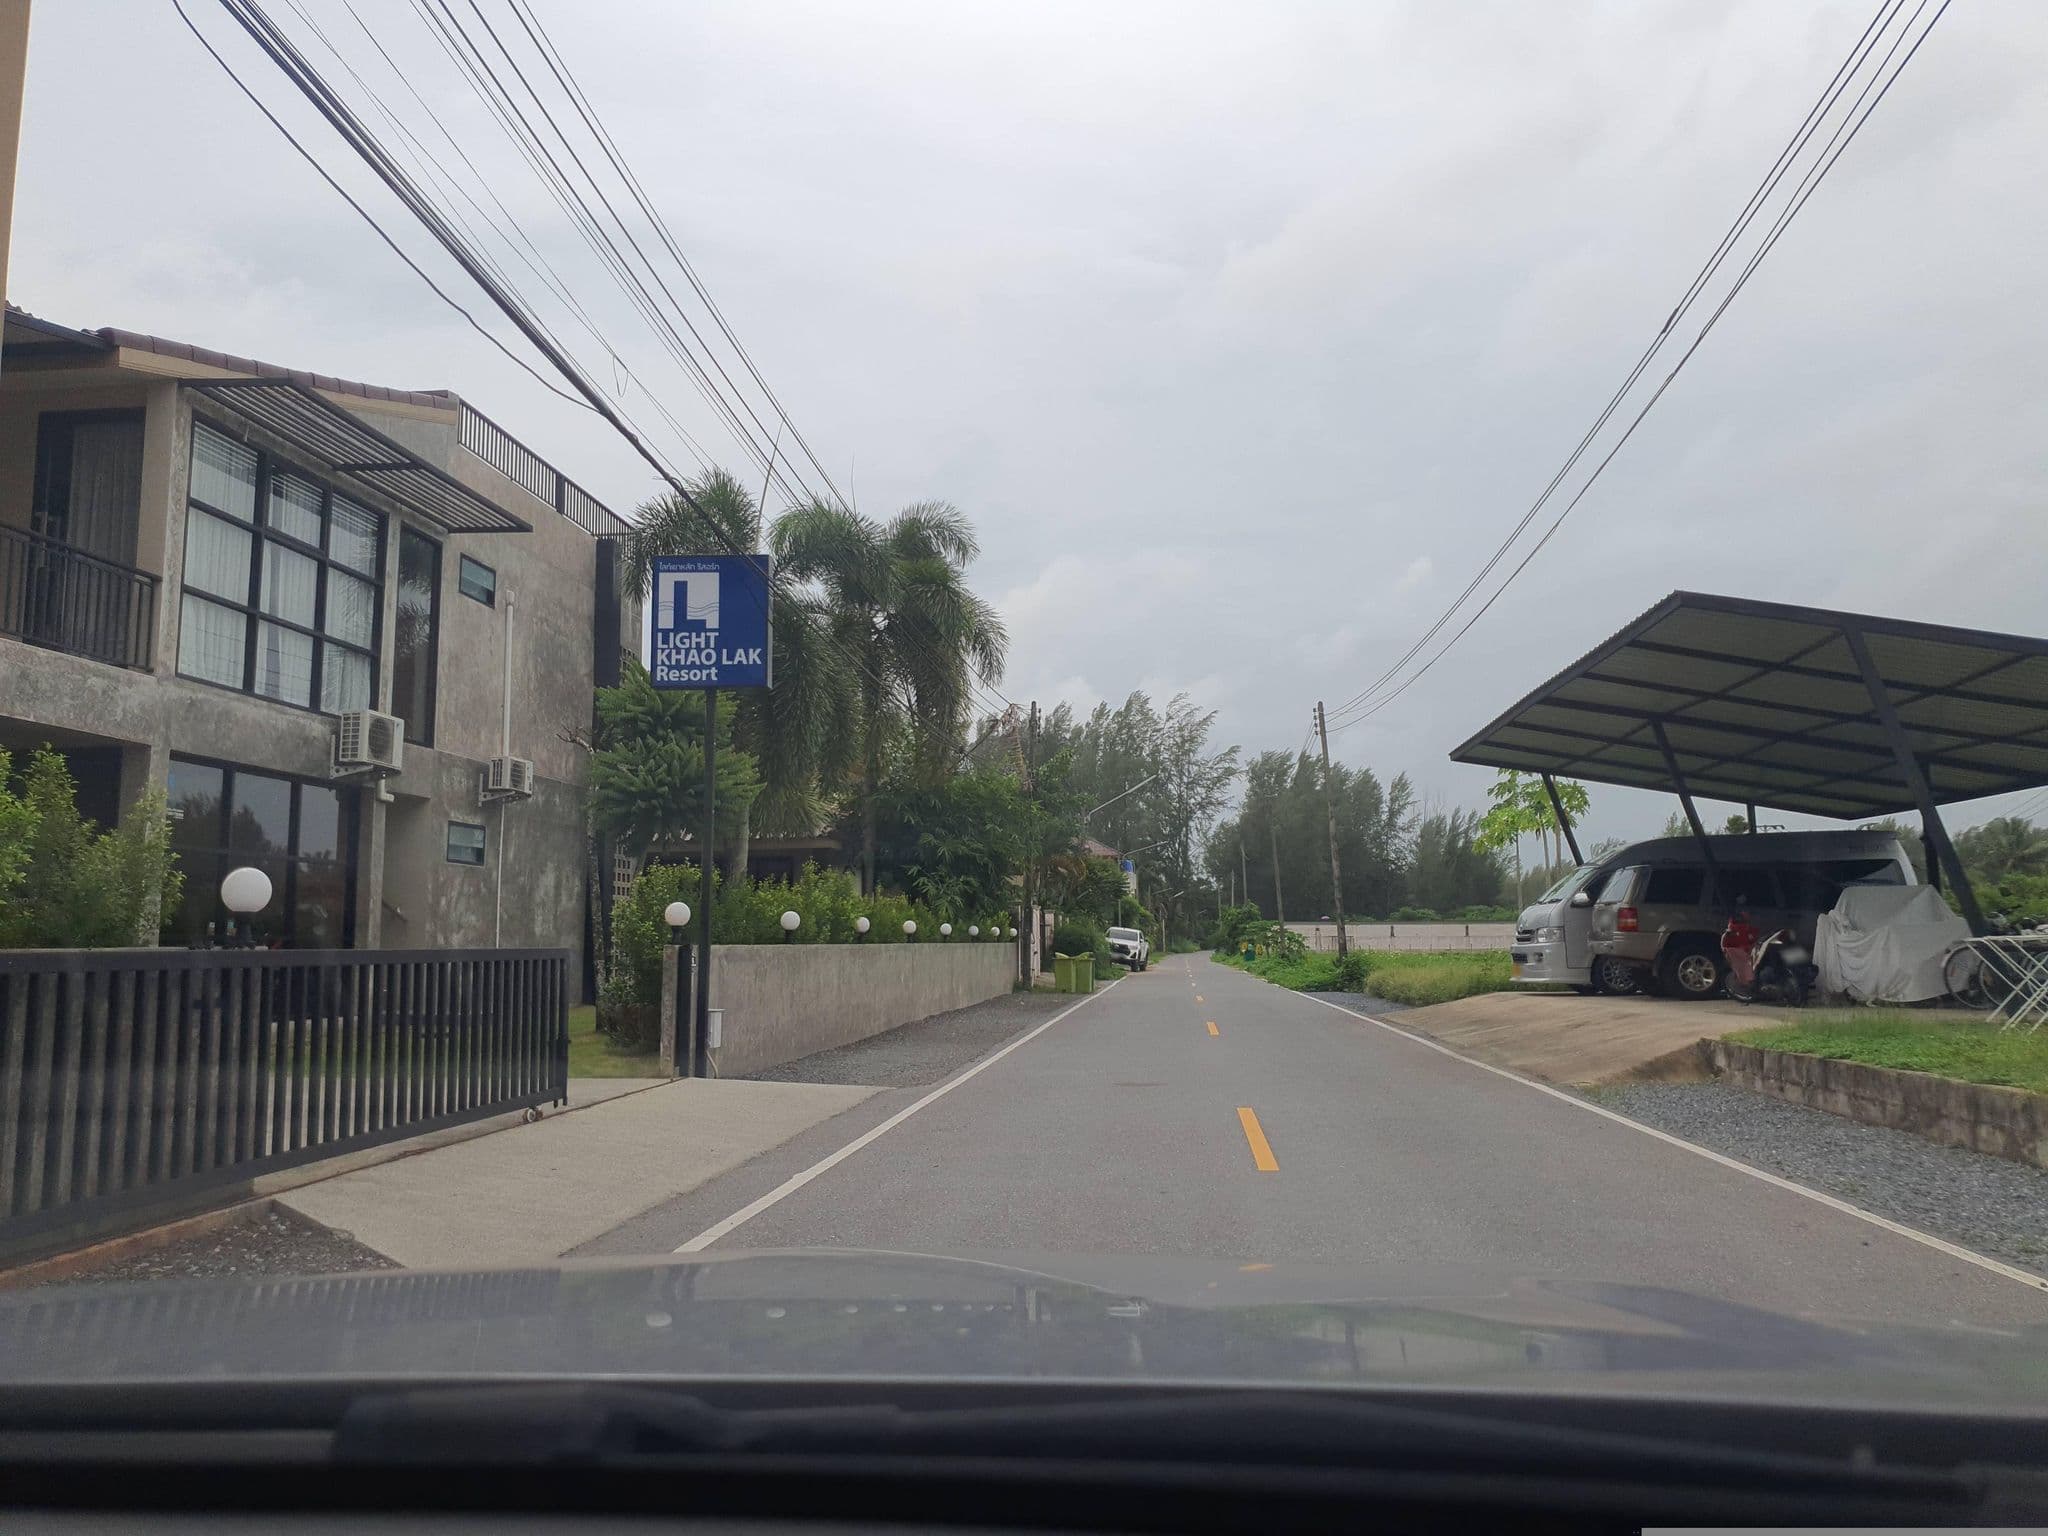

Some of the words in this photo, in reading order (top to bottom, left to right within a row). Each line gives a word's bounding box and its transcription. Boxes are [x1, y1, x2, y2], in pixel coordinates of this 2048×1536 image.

[657, 632, 719, 649] LIGHT
[657, 649, 717, 665] KHAO
[722, 648, 762, 665] LAK
[656, 666, 718, 681] Resort
